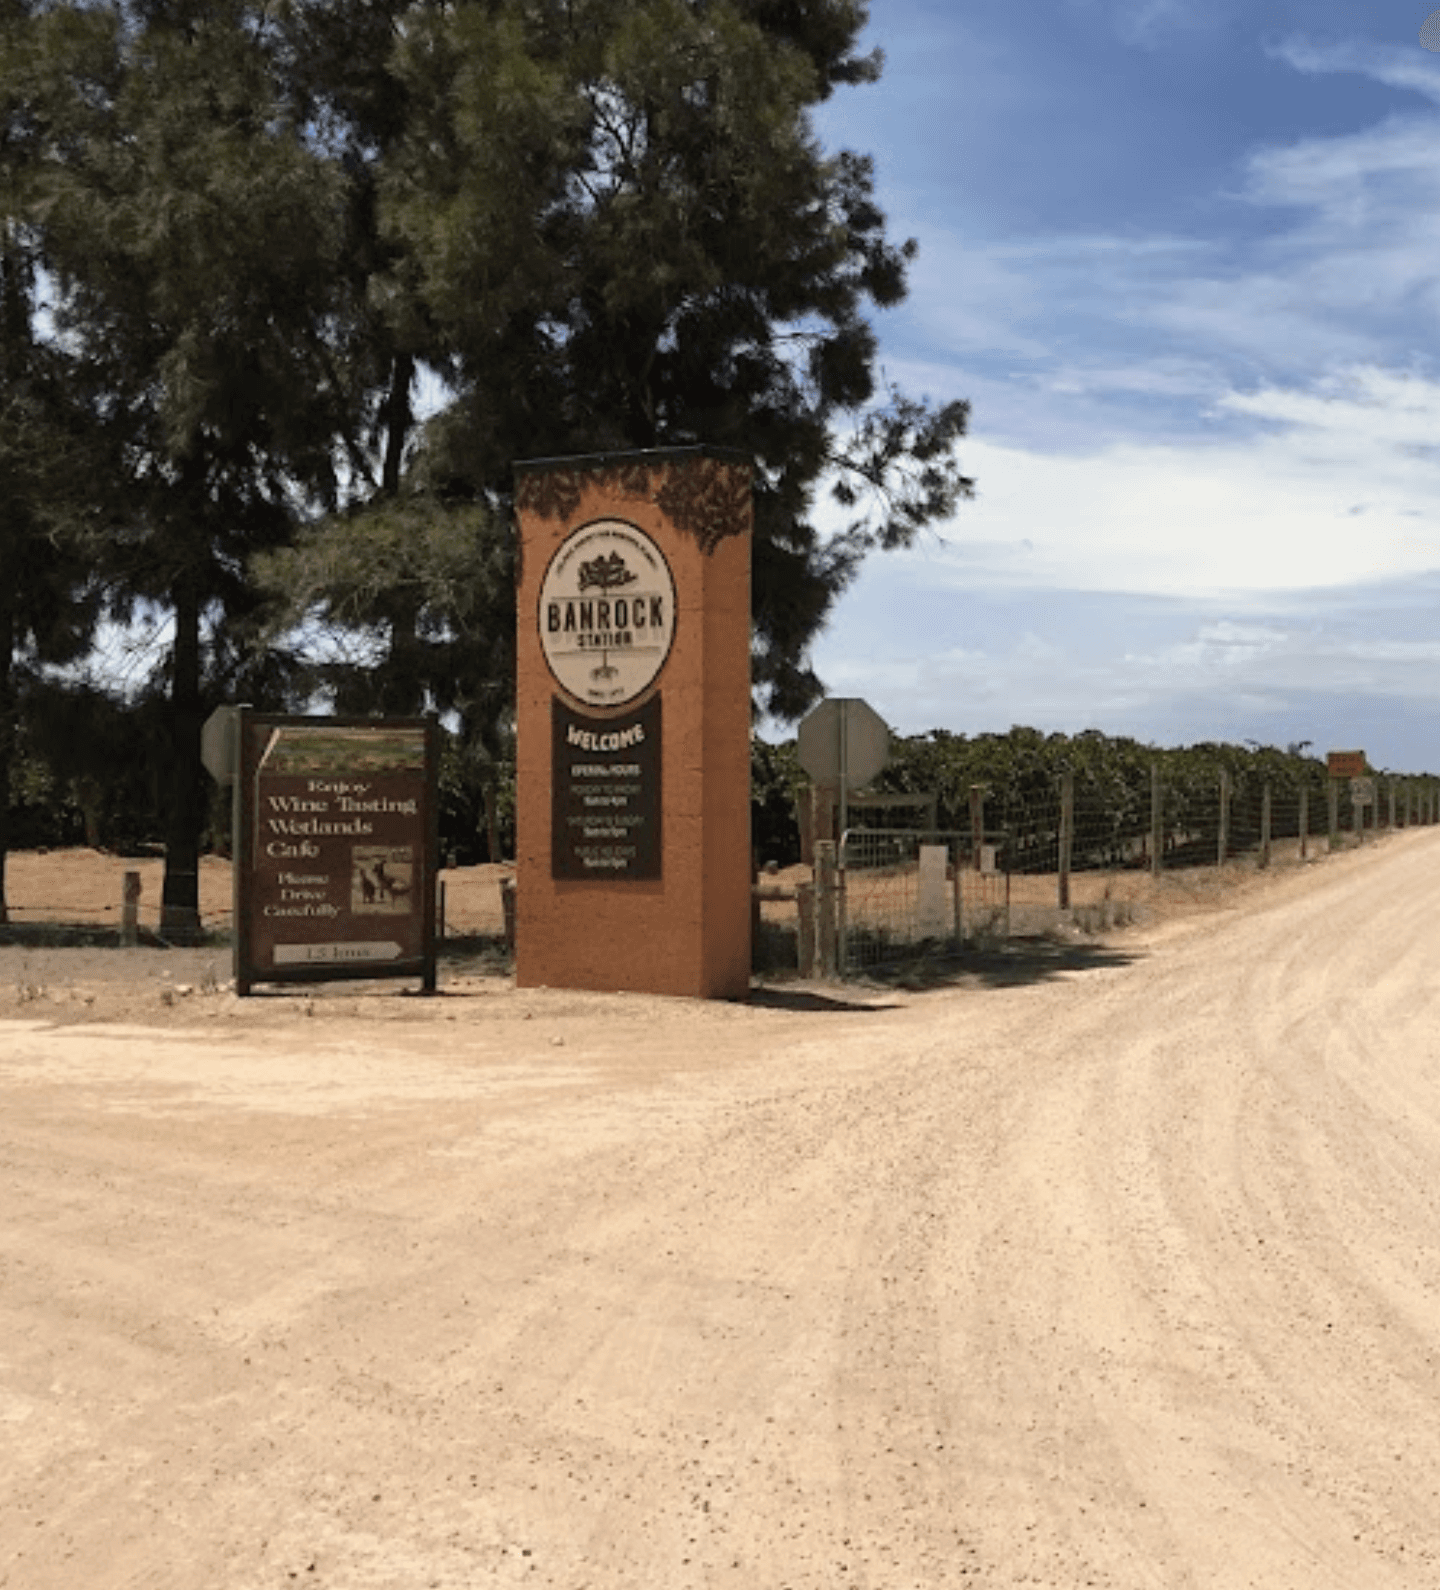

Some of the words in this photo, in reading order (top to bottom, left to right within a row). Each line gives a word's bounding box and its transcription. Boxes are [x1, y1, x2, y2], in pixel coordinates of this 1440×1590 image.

[547, 596, 663, 633] BANROCK
[576, 631, 633, 648] STATION
[567, 723, 646, 751] WELCOME
[307, 780, 372, 796] Enjoy
[267, 796, 329, 812] Wine
[333, 795, 418, 815] Tasting
[267, 816, 373, 835] Wetlands
[262, 902, 343, 918] Carefully
